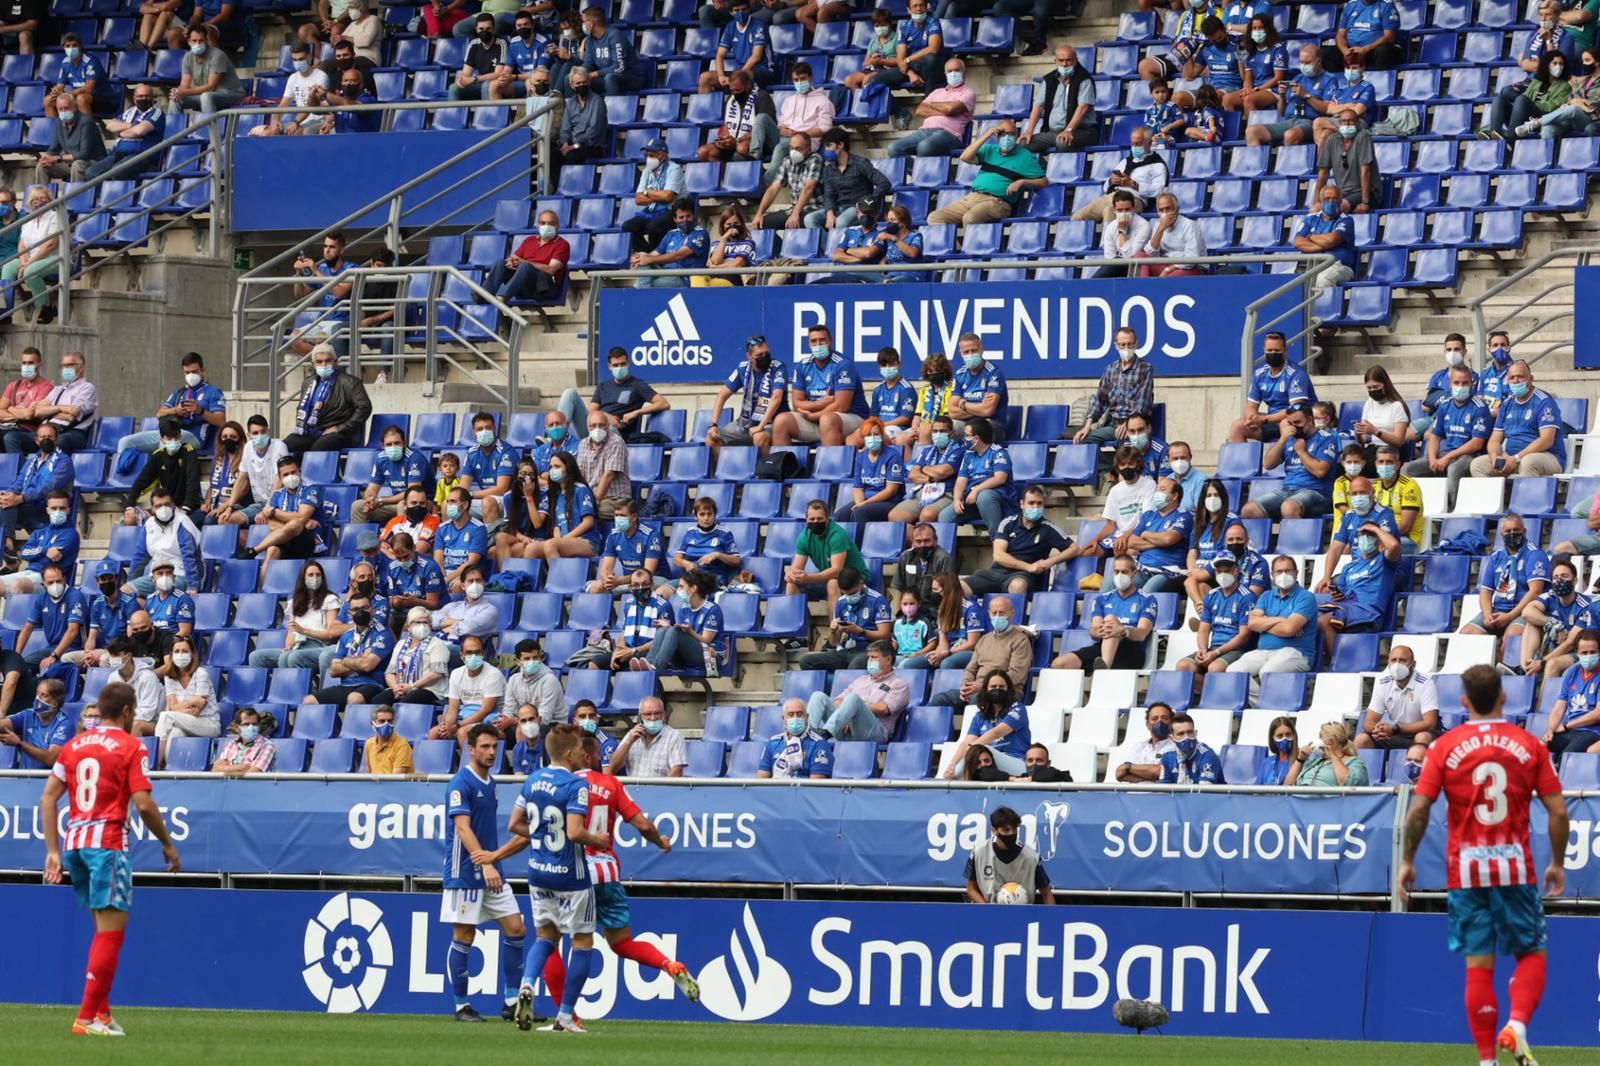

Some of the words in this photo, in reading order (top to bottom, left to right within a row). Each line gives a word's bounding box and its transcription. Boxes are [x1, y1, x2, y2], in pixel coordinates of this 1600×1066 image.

[793, 293, 1196, 364] BIENVENIDOS
[631, 338, 713, 367] adidas
[1446, 738, 1481, 770] DIEGO
[1482, 734, 1532, 764] ALENDE
[75, 757, 101, 813] 8
[530, 779, 557, 797] MOSSA
[589, 783, 611, 800] RES
[1472, 761, 1508, 825] 3
[527, 801, 566, 853] 23
[1102, 819, 1368, 861] SOLUCIONES
[462, 888, 478, 904] 10
[808, 916, 1272, 1016] SmartBank
